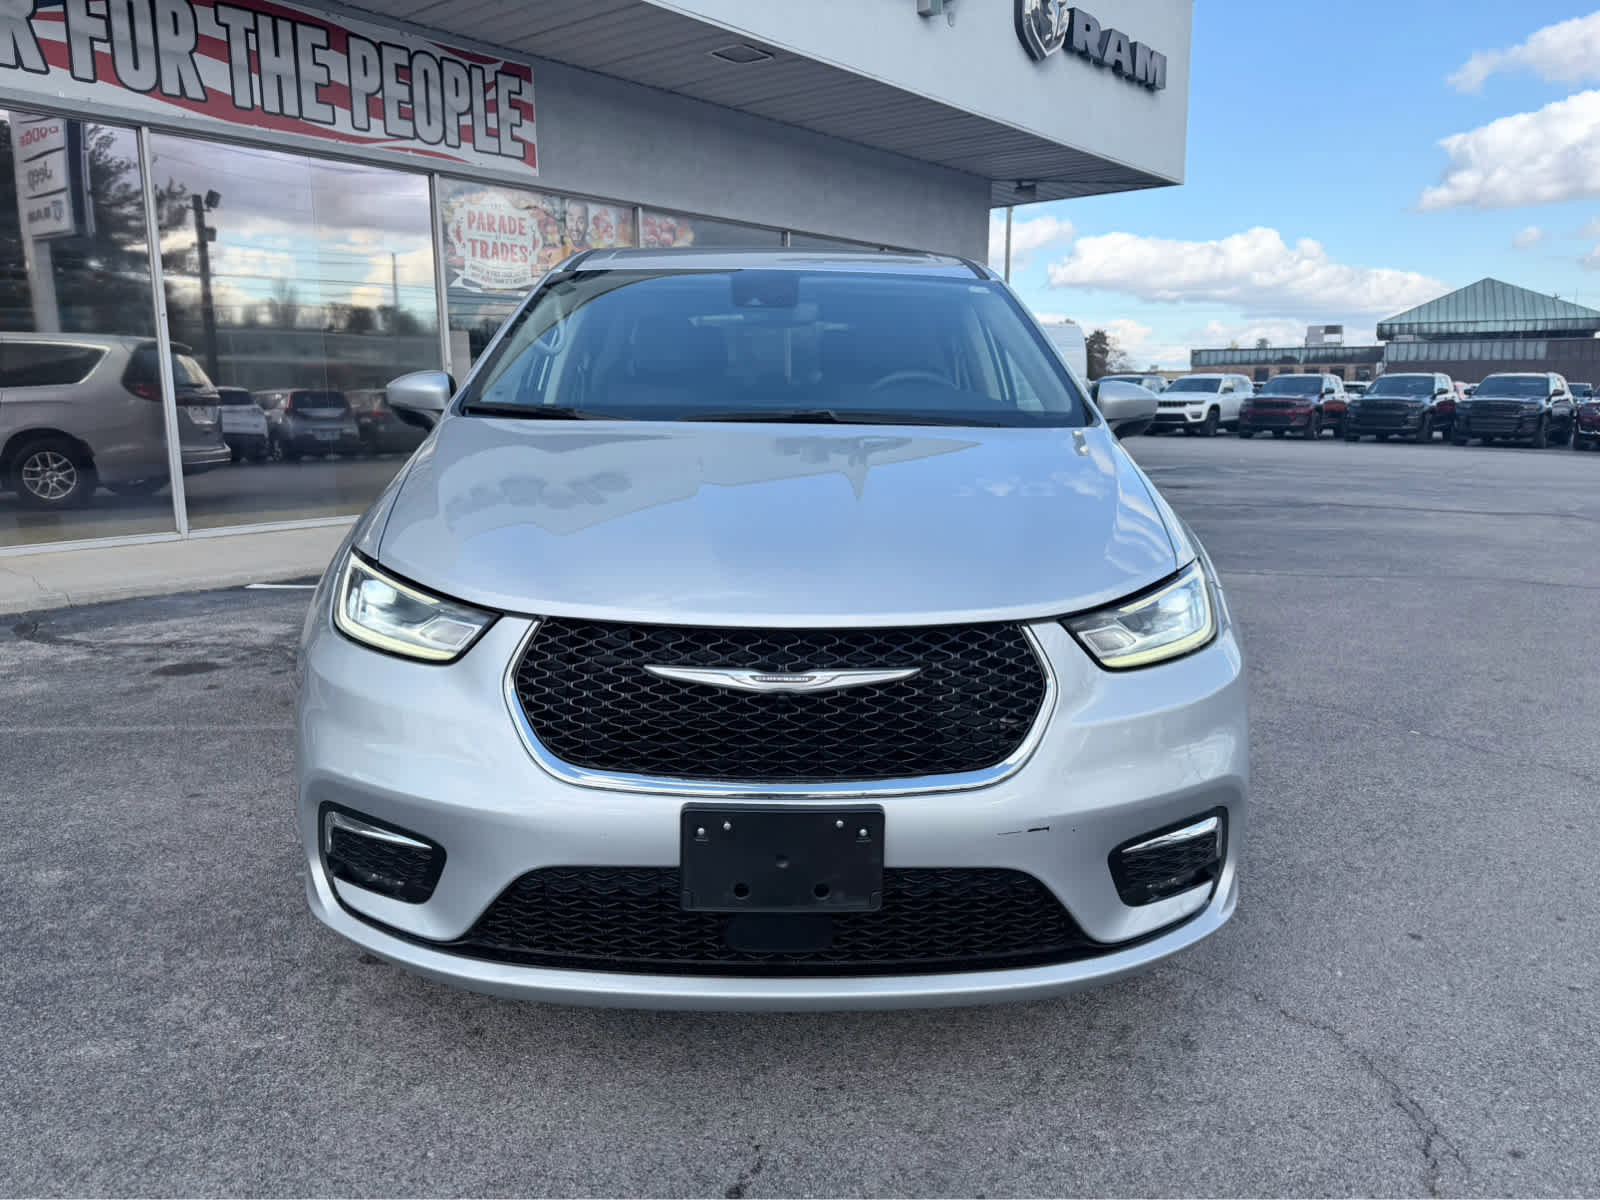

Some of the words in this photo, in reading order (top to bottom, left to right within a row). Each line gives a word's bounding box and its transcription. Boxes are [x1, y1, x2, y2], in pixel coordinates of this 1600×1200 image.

[1066, 7, 1167, 90] RAM
[64, 0, 208, 102] FOR
[215, 4, 337, 126] THE
[347, 33, 526, 160] PEOPLE
[467, 209, 528, 236] PARADE
[467, 238, 529, 263] TRADES
